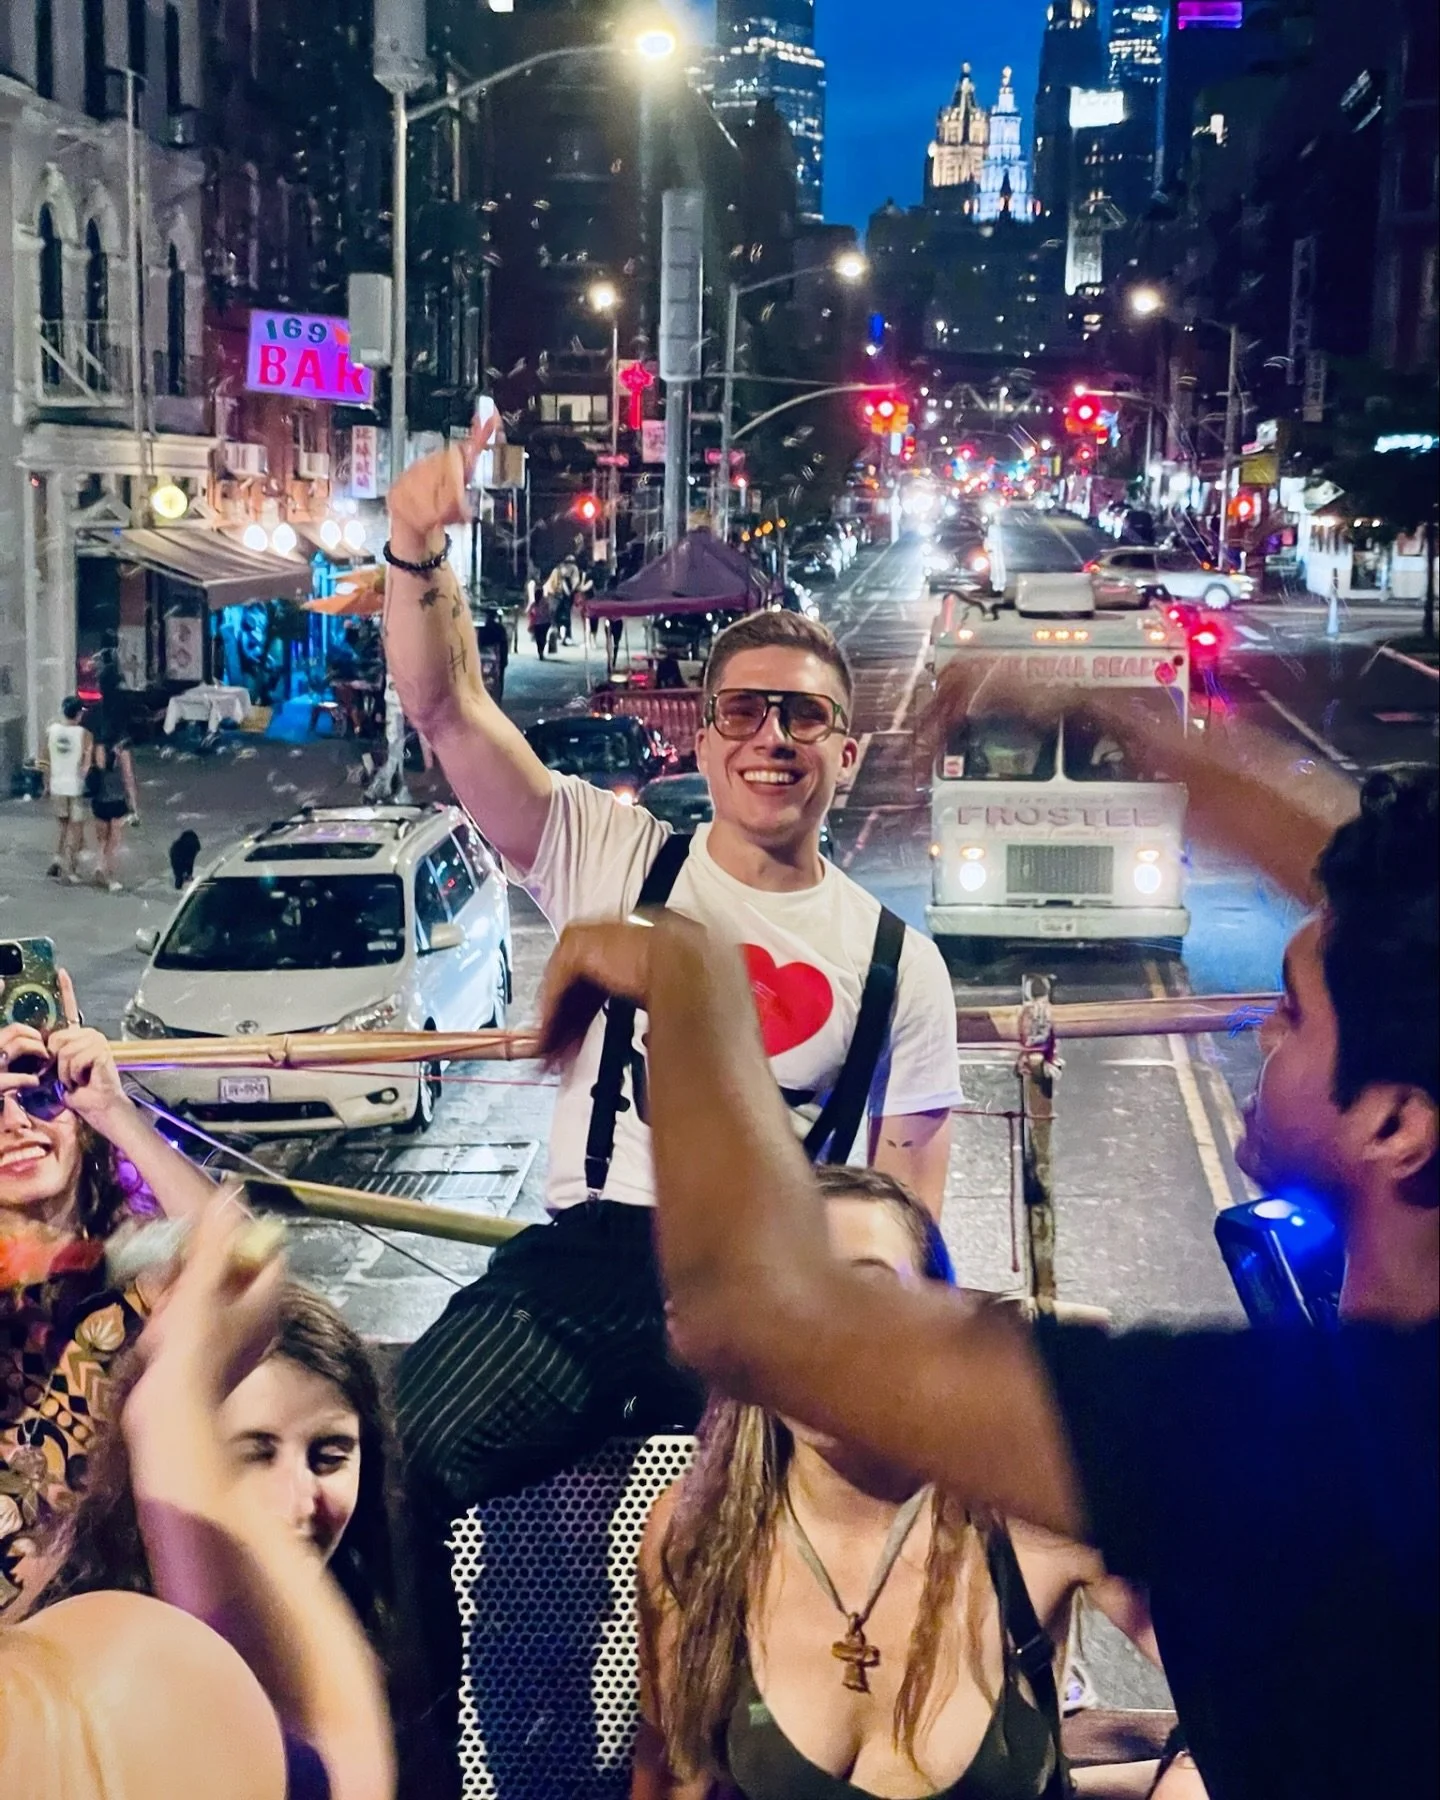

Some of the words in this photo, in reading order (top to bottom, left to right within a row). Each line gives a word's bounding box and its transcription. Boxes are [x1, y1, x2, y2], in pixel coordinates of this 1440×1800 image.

[265, 317, 327, 344] 169
[258, 344, 366, 395] BAR
[957, 806, 1164, 828] FROSTEE
